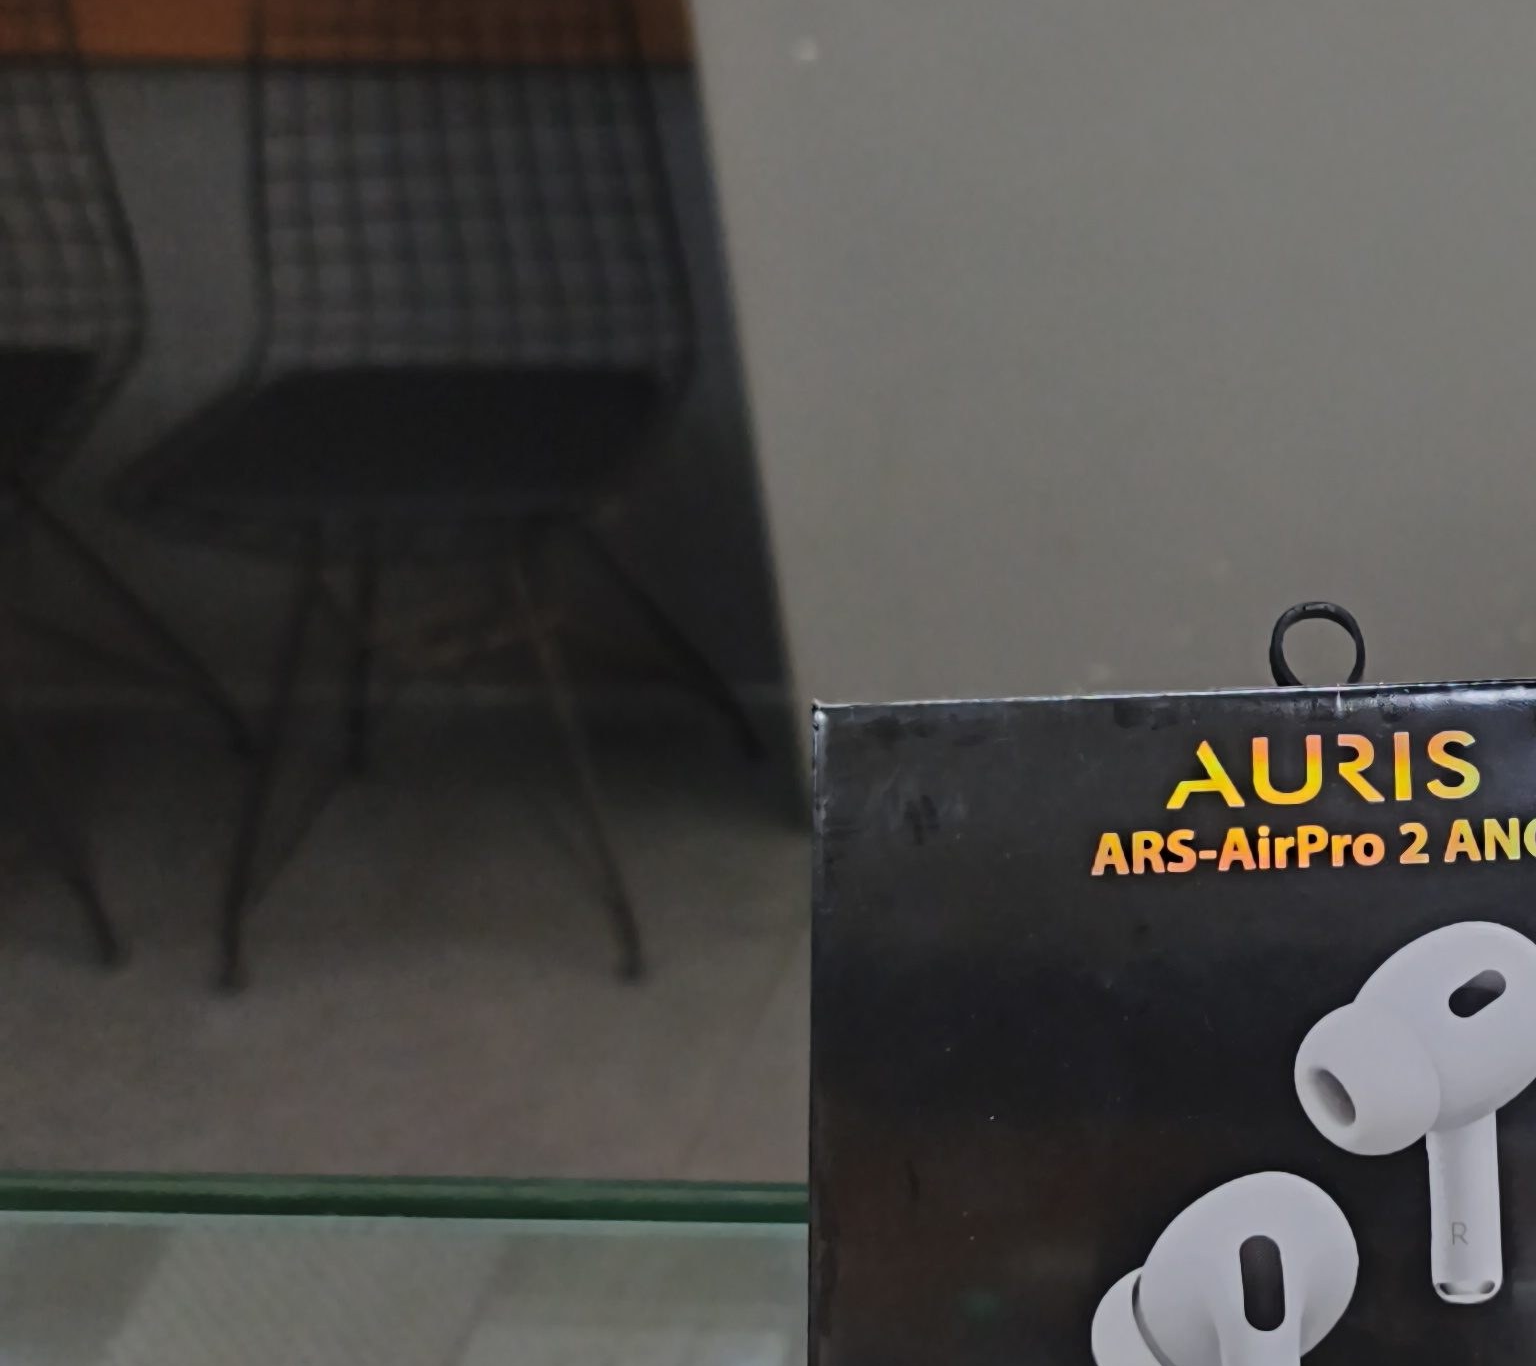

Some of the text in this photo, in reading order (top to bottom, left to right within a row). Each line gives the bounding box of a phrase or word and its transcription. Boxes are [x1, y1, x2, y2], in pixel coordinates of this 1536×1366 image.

[1165, 729, 1481, 810] AURIS
[1090, 824, 1386, 877] ARS-AirPro
[1398, 821, 1431, 865] 2
[1450, 1221, 1470, 1246] R
